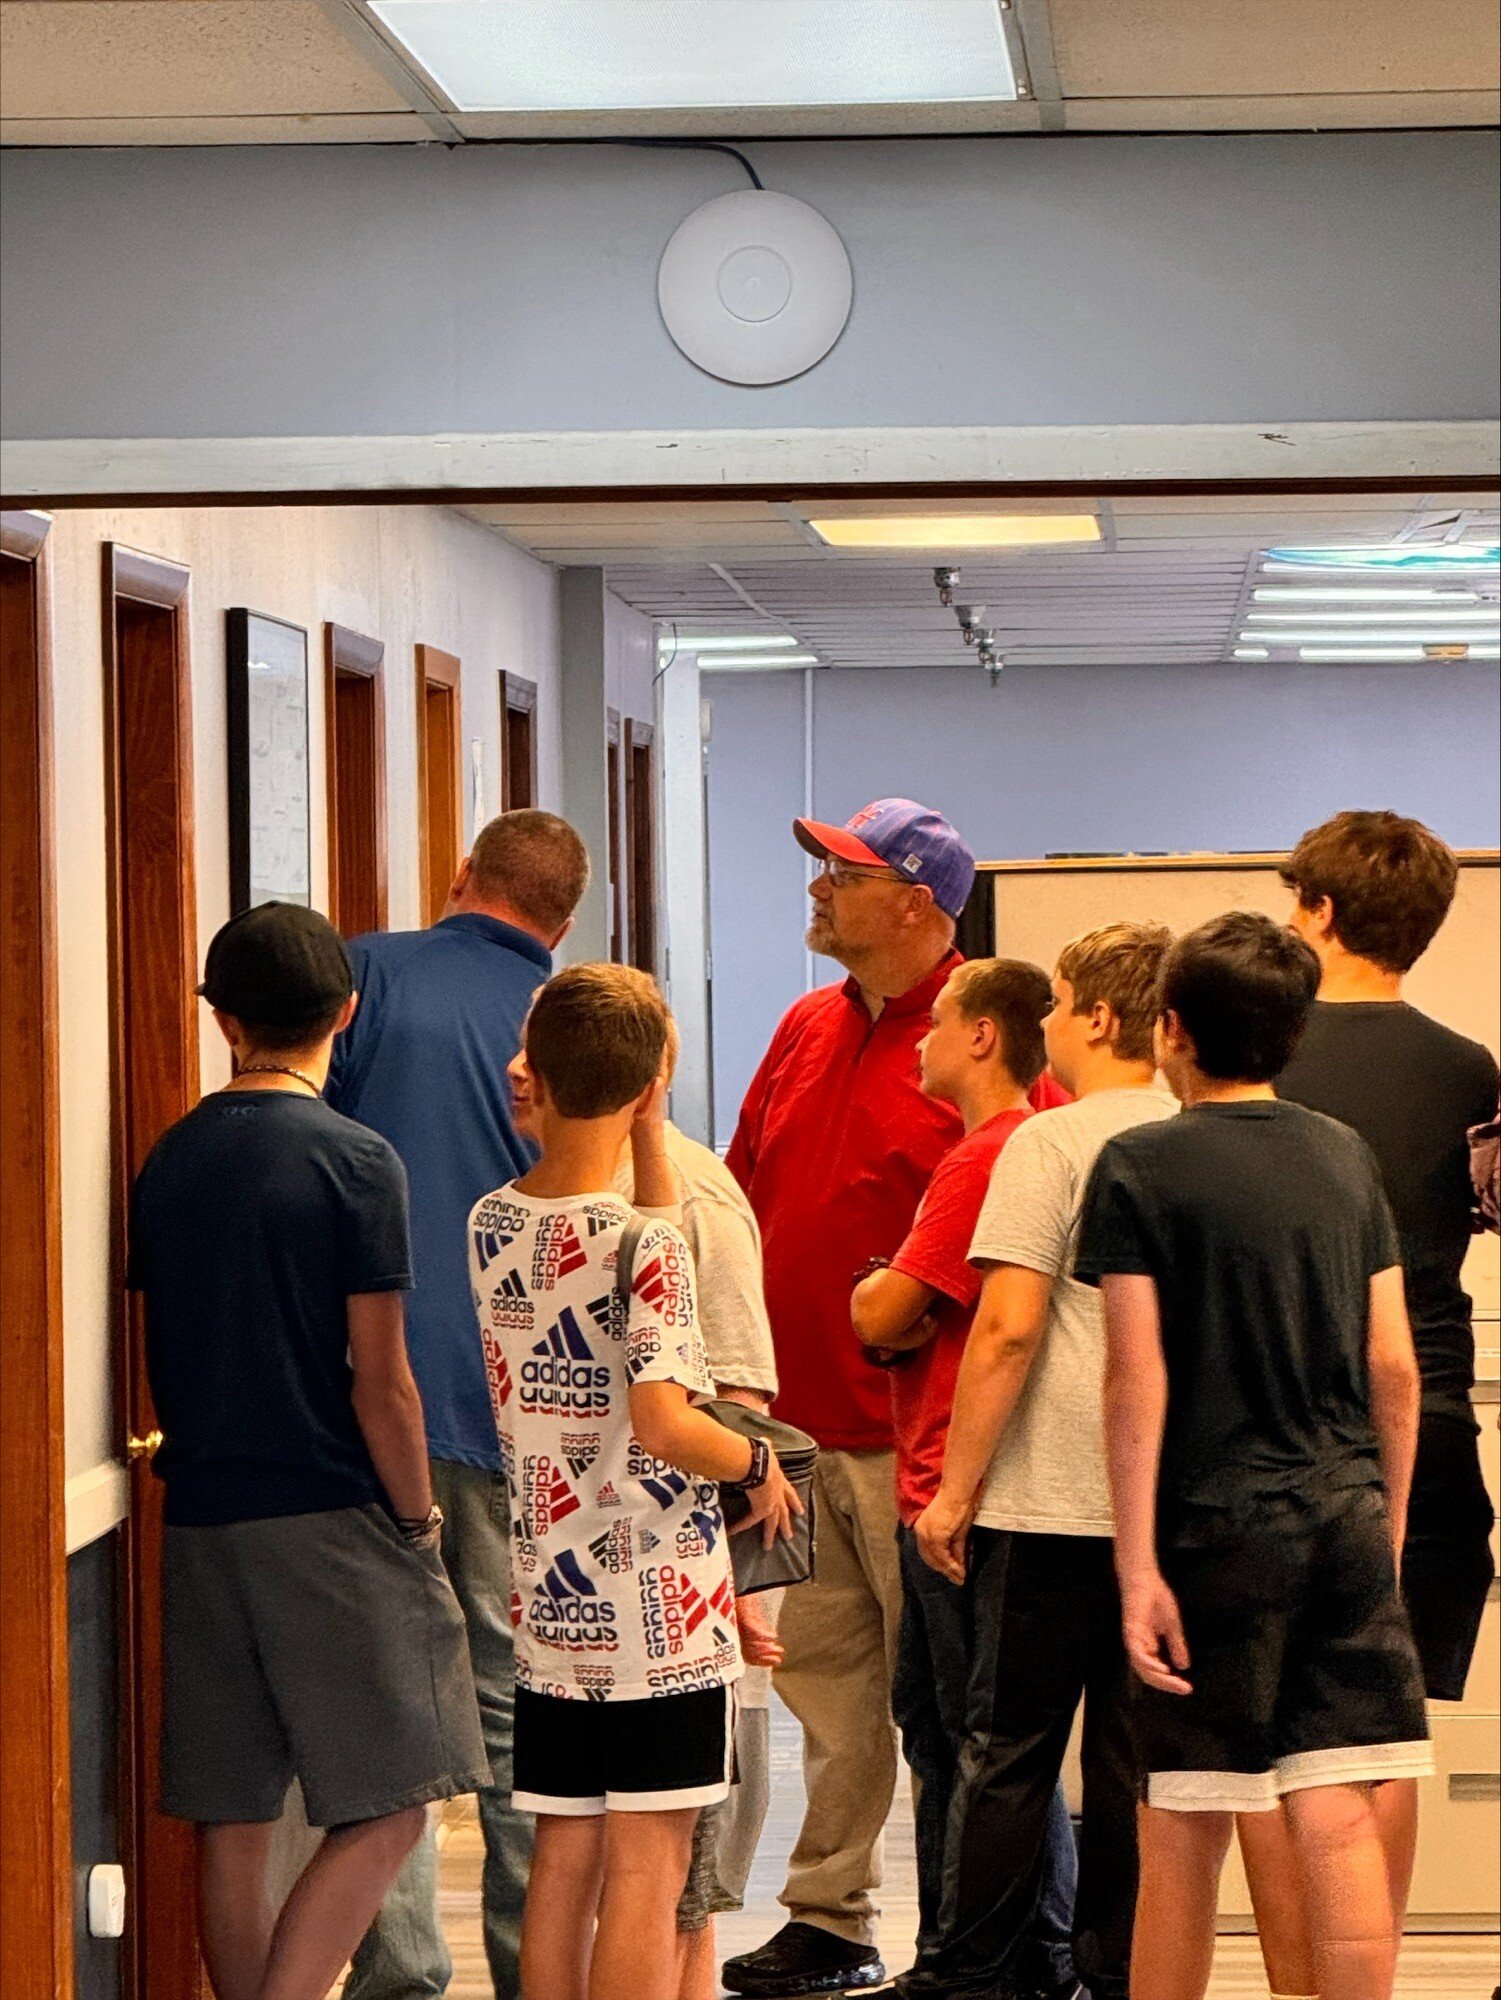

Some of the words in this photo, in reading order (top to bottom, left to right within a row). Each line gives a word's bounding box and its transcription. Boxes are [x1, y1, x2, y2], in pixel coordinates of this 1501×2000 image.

[545, 1214, 567, 1291] adidas
[491, 1297, 534, 1314] adidas
[662, 1241, 681, 1326] adidas
[521, 1357, 610, 1388] adidas
[626, 1342, 661, 1358] adid
[535, 1456, 551, 1536] adidas
[606, 1520, 621, 1574] adidas
[529, 1596, 616, 1623] adidas
[659, 1565, 684, 1654] adidas
